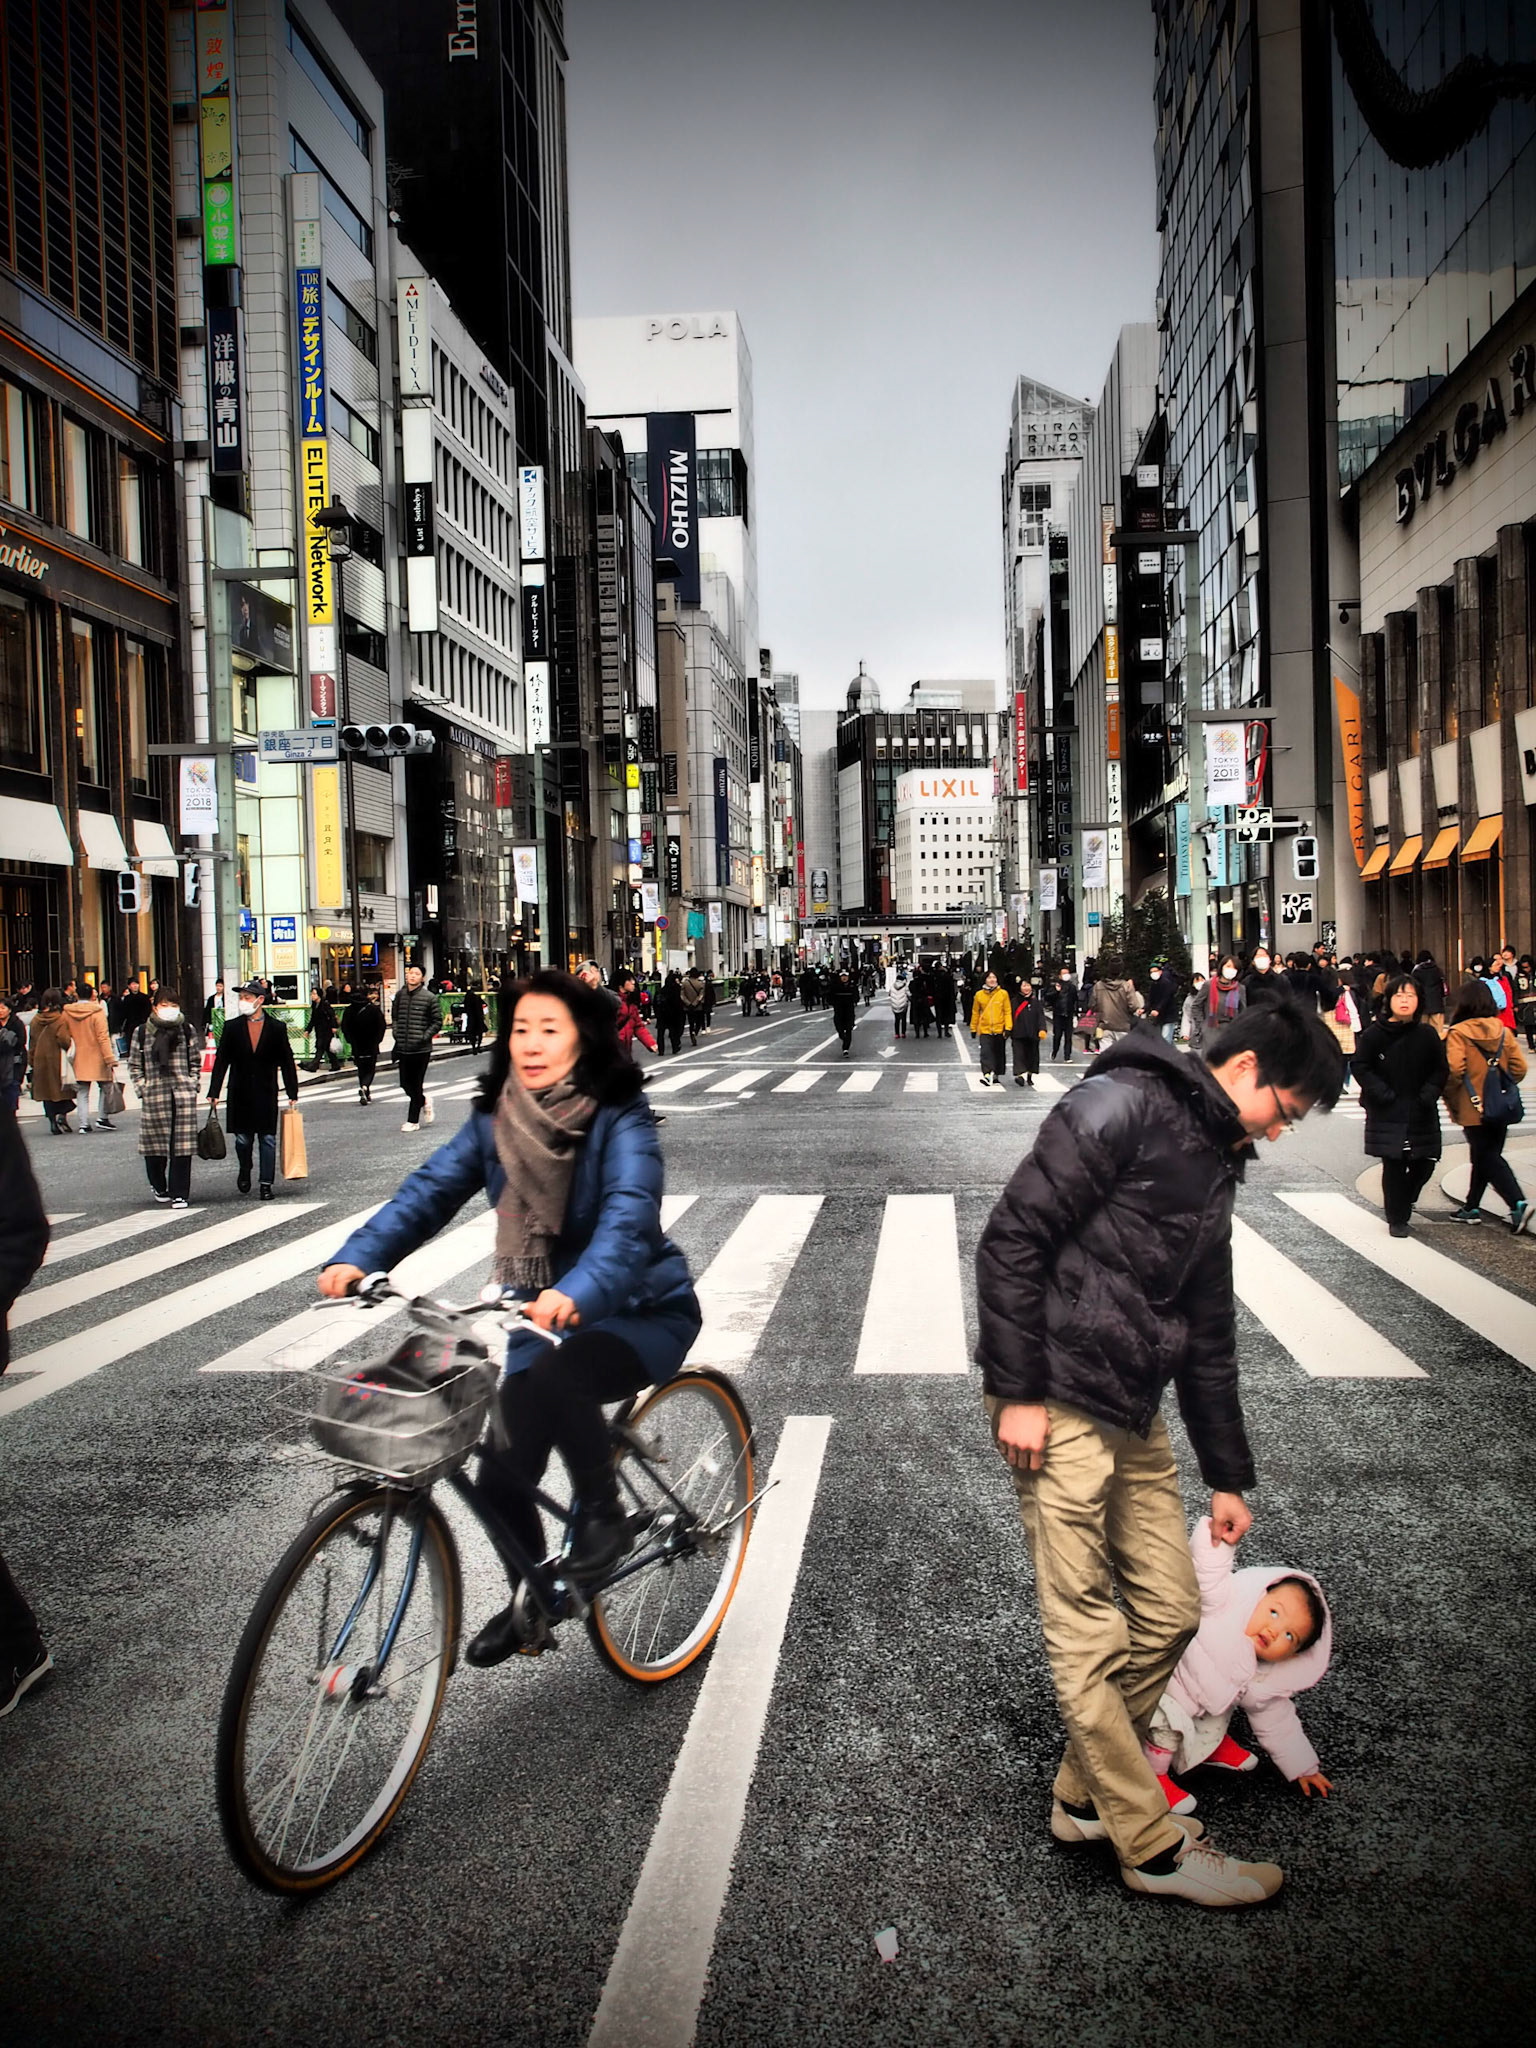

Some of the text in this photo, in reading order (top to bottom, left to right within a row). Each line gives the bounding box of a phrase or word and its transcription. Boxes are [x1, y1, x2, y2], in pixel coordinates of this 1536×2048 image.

[647, 316, 729, 342] POLA
[300, 273, 323, 433] TDR 旅のデザインルーム
[214, 333, 238, 448] 洋服の青山
[1027, 422, 1078, 432] KIRA
[1028, 432, 1078, 443] RITO
[1028, 444, 1079, 453] GINZA
[670, 449, 690, 549] MIZUHO
[307, 447, 326, 618] ELITE Network.
[264, 736, 333, 751] 銀座二丁目
[285, 750, 305, 758] Ginza
[751, 735, 759, 768] ALBION
[1213, 768, 1240, 778] 2018
[920, 778, 979, 798] LIXIL
[186, 797, 212, 807] 2018
[670, 857, 678, 892] BRIDAL
[273, 920, 294, 928] 洋服の
[273, 928, 295, 940] 青山
